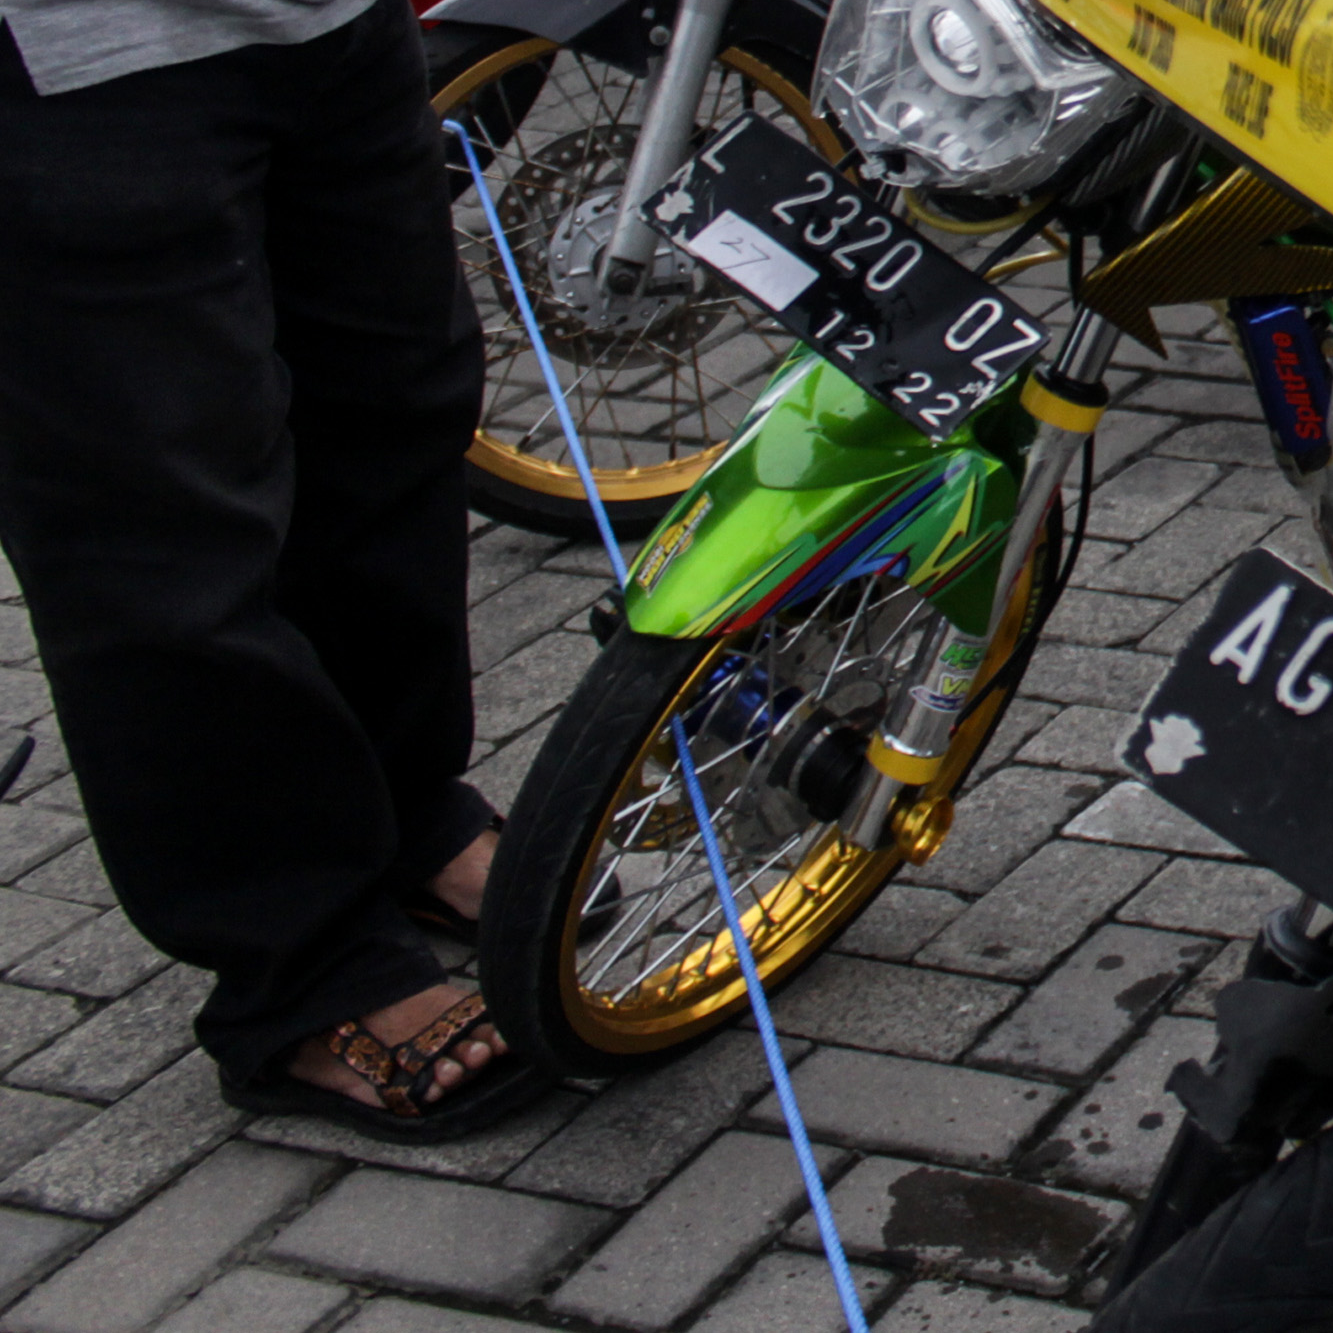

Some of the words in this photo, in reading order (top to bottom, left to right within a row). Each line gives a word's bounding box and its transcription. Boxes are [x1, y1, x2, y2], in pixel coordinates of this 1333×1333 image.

[719, 235, 770, 267] 27
[771, 170, 924, 292] 2320
[814, 308, 876, 362] 12
[891, 371, 962, 427] 22
